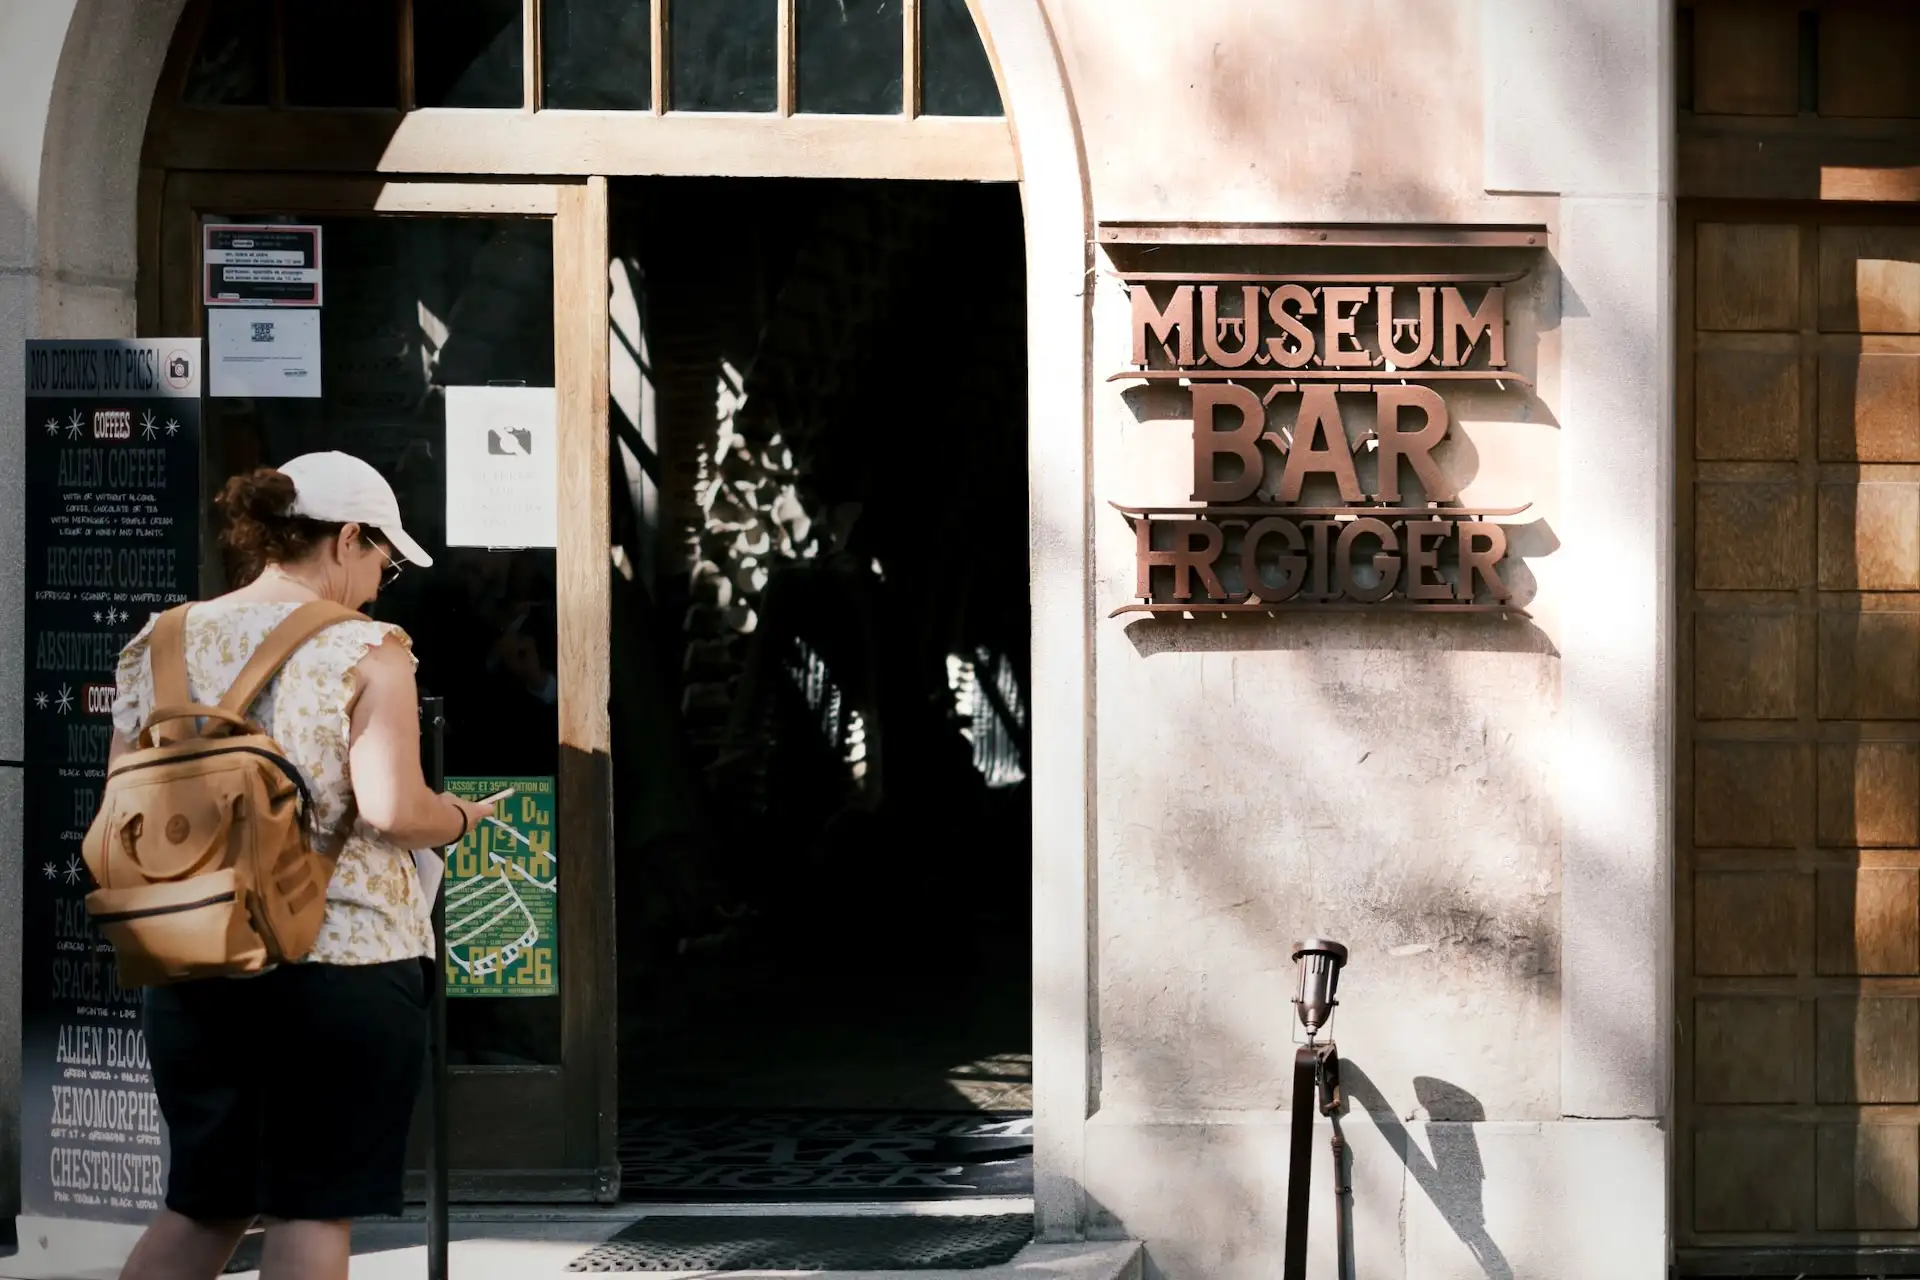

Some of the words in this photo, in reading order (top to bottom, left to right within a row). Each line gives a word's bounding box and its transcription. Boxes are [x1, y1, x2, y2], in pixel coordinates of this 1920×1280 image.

[1129, 284, 1507, 368] MUSEUM
[31, 350, 48, 390] NO
[104, 349, 121, 391] NO
[94, 411, 131, 439] COFFEES
[1189, 383, 1461, 503] BAR
[57, 448, 103, 488] ALIEN
[108, 448, 167, 489] COFFEE
[118, 528, 133, 537] AND
[118, 548, 177, 588] COFFEE
[113, 592, 128, 601] AND
[35, 630, 113, 671] ABSINTHE
[88, 686, 118, 713] COCKT
[67, 723, 114, 763] NOST
[478, 782, 488, 791] ET
[539, 782, 549, 792] DU
[51, 957, 102, 1001] SPACE
[56, 1023, 102, 1066] ALIEN
[63, 1068, 87, 1079] GREEN
[50, 1146, 163, 1196] CHESTBUSTER
